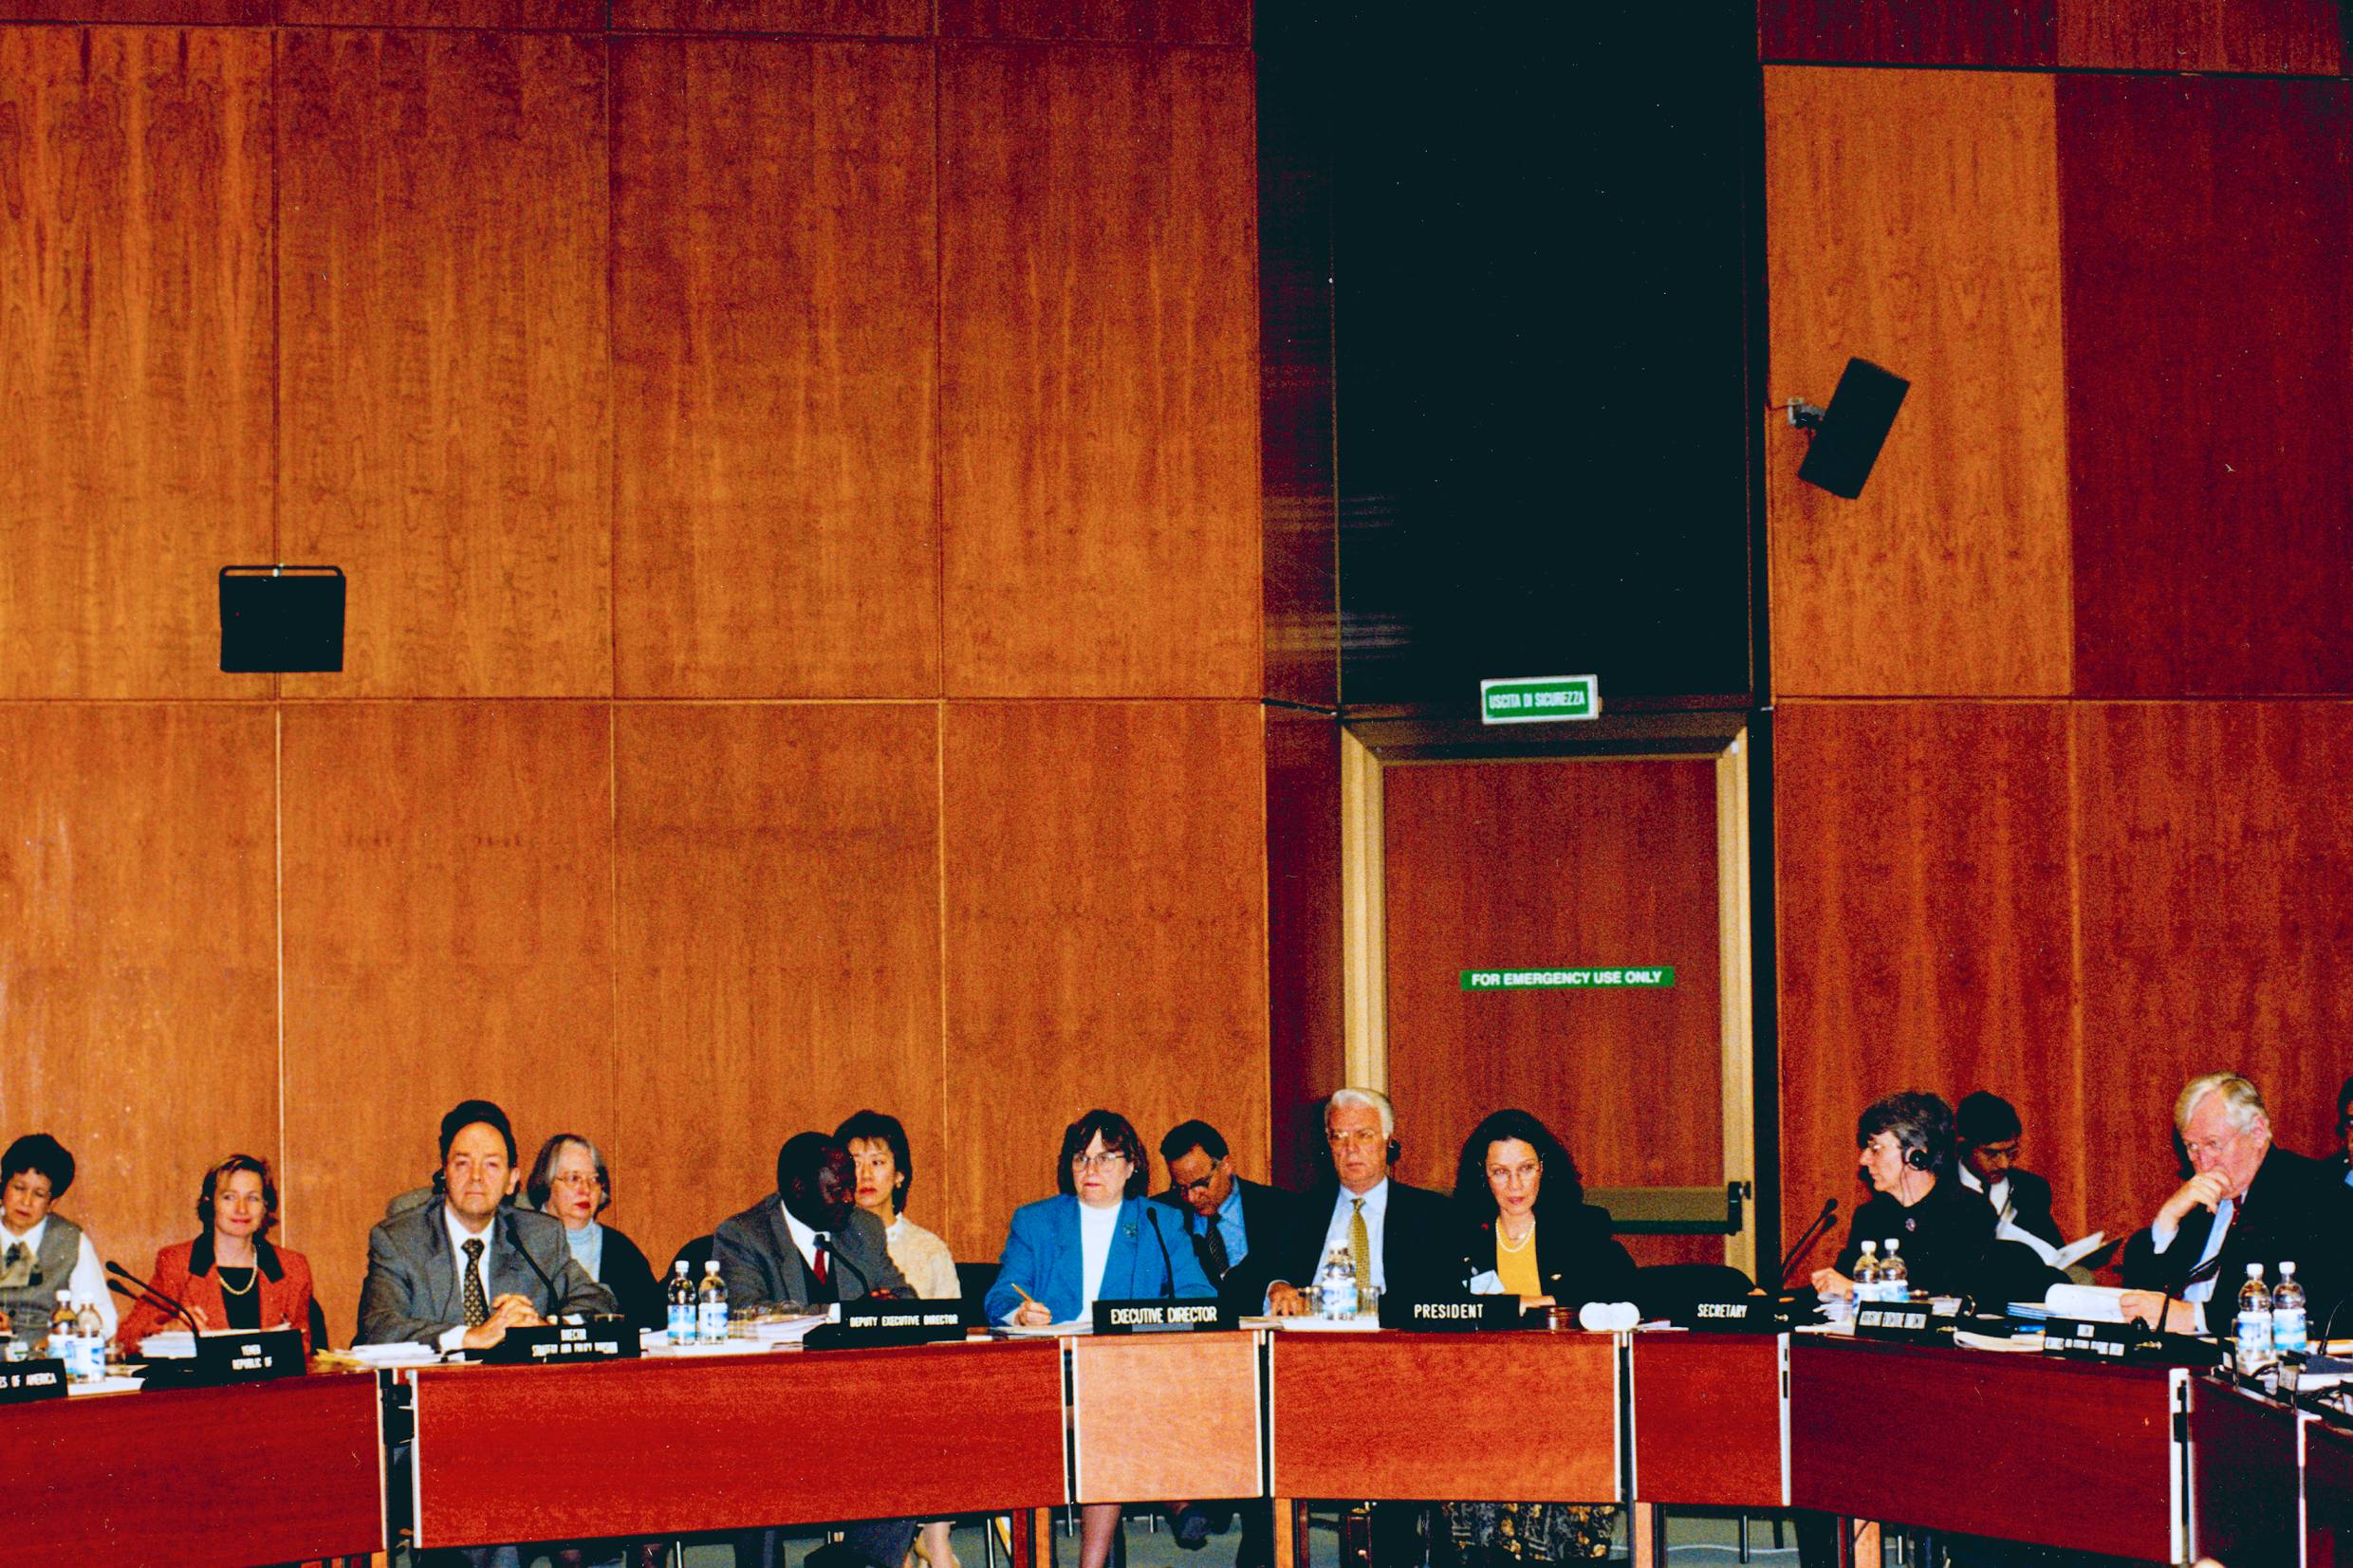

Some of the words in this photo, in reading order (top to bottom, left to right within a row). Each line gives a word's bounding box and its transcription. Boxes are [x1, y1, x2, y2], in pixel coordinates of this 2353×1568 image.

[1489, 693, 1521, 710] USCITA
[1523, 693, 1532, 708] DI
[1535, 691, 1585, 707] SICUREZZA
[1473, 974, 1500, 986] FOR
[1504, 972, 1589, 985] EMERGENCY
[1594, 971, 1621, 984] USE
[1625, 971, 1661, 983] ONLY
[1110, 1307, 1164, 1324] EXECUTIVE
[1167, 1305, 1217, 1322] DIRECTOR
[1415, 1304, 1483, 1319] PRESIDENT
[1697, 1304, 1747, 1318] SECRETARY
[850, 1317, 878, 1327] DEPUTY
[881, 1316, 919, 1326] EXECUTIVE
[923, 1314, 958, 1325] DIRECTOR
